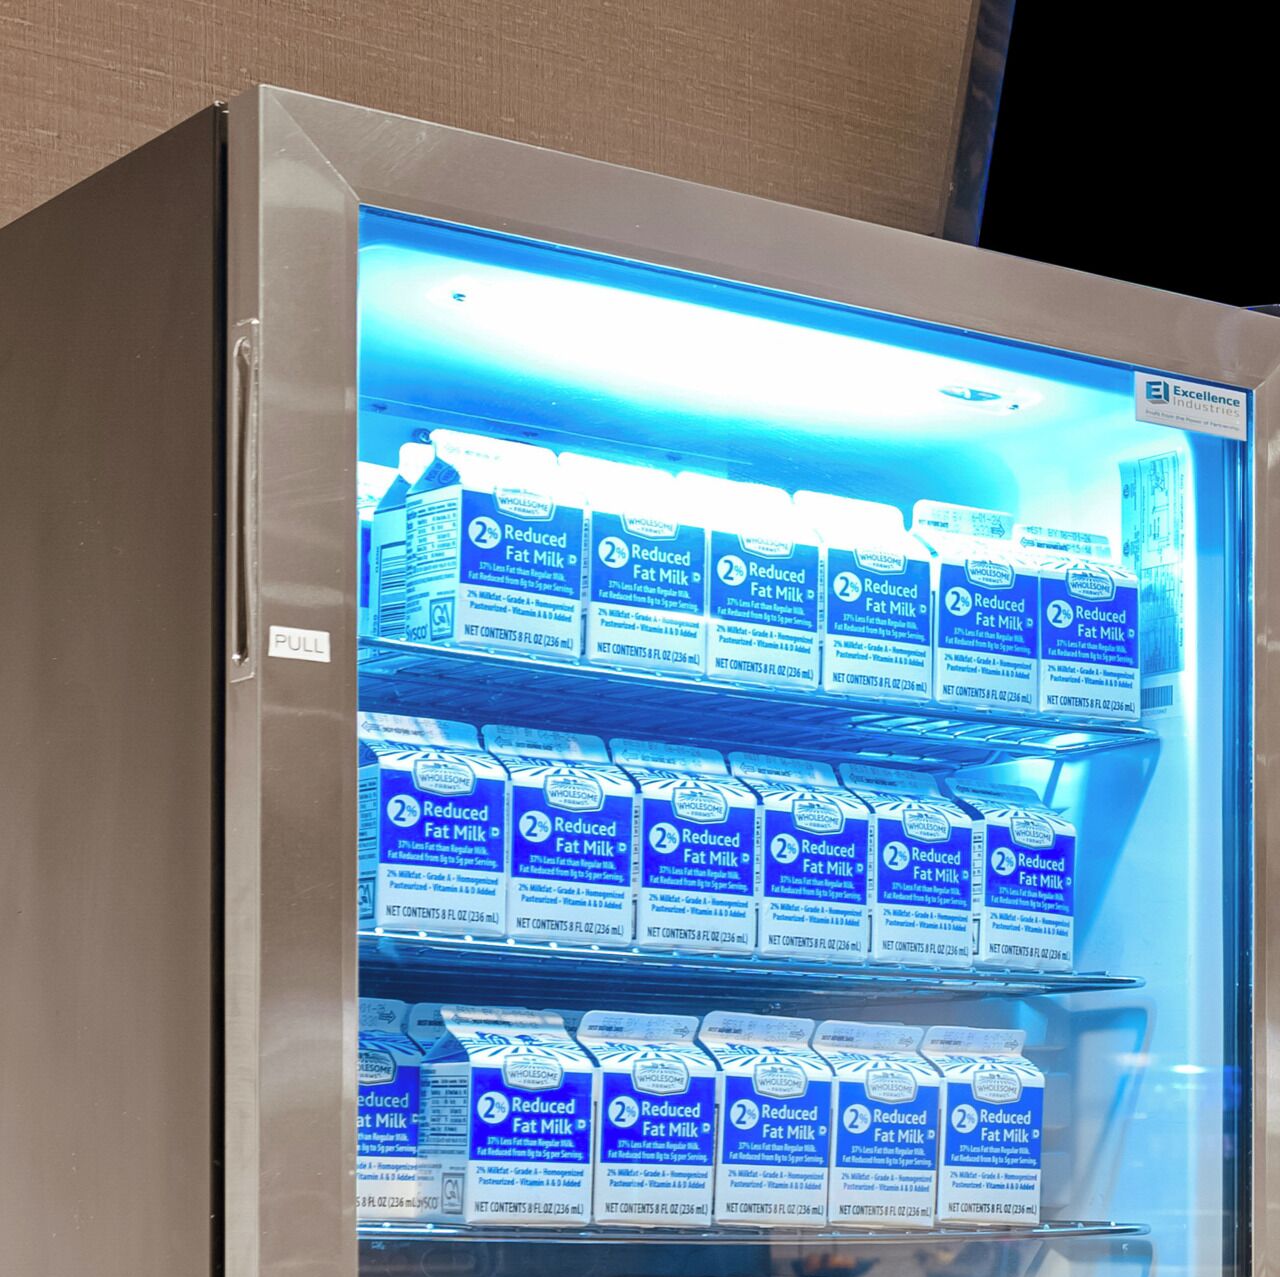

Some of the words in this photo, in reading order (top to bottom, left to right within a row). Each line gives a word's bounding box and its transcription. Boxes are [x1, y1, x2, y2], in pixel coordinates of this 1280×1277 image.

[1173, 385, 1240, 407] Excellence
[1173, 397, 1239, 418] Industries
[474, 521, 498, 543] 2%
[505, 525, 567, 548] Reduced
[506, 546, 529, 562] Fat
[534, 551, 564, 568] Milk
[604, 541, 626, 563] 2%
[632, 545, 690, 566] Reduced
[634, 565, 655, 581] Fat
[660, 569, 689, 585] Milk
[840, 577, 859, 597] 2%
[864, 578, 918, 598] Reduced
[1071, 582, 1110, 593] WHOLESOME
[866, 599, 886, 613] Fat
[890, 602, 916, 617] Milk
[951, 591, 969, 611] 2%
[975, 593, 1024, 612] Reduced
[976, 612, 994, 626] Fat
[1000, 615, 1023, 631] Milk
[1052, 605, 1071, 623] 2%
[1076, 605, 1126, 624] Reduced
[1078, 624, 1095, 638] Fat
[1101, 627, 1125, 640] Milk
[275, 634, 324, 654] PULL
[393, 800, 417, 821] 2%
[424, 801, 488, 821] Reduced
[425, 823, 449, 839] Fat
[454, 826, 486, 842] Milk
[526, 815, 548, 837] 2%
[555, 818, 616, 837] Reduced
[655, 827, 677, 848] 2%
[683, 829, 739, 847] Reduced
[556, 840, 579, 855] Fat
[584, 842, 614, 857] Milk
[684, 849, 705, 864] Fat
[710, 852, 738, 867] Milk
[996, 852, 1014, 870] 2%
[1018, 854, 1065, 872] Reduced
[1020, 872, 1037, 886] Fat
[1041, 874, 1064, 890] Milk
[483, 1097, 506, 1118] 2%
[512, 1097, 575, 1115] Reduced
[615, 1100, 636, 1122] 2%
[642, 1101, 700, 1118] Reduced
[513, 1119, 536, 1134] Fat
[541, 1120, 572, 1134] Milk
[848, 1109, 868, 1129] 2%
[873, 1109, 927, 1125] Reduced
[956, 1109, 976, 1128] 2%
[980, 1109, 1031, 1125] Reduced
[643, 1122, 665, 1136] Fat
[670, 1122, 698, 1138] Milk
[875, 1128, 895, 1142] Fat
[898, 1129, 924, 1143] Milk
[981, 1128, 1000, 1141] Fat
[1003, 1129, 1029, 1142] Milk
[475, 1201, 488, 1212] NET
[490, 1203, 526, 1214] CONTENTS
[527, 1204, 532, 1214] 8
[534, 1204, 542, 1214] FL
[543, 1204, 553, 1215] OZ
[554, 1204, 570, 1216] (236
[571, 1204, 584, 1215] mL)
